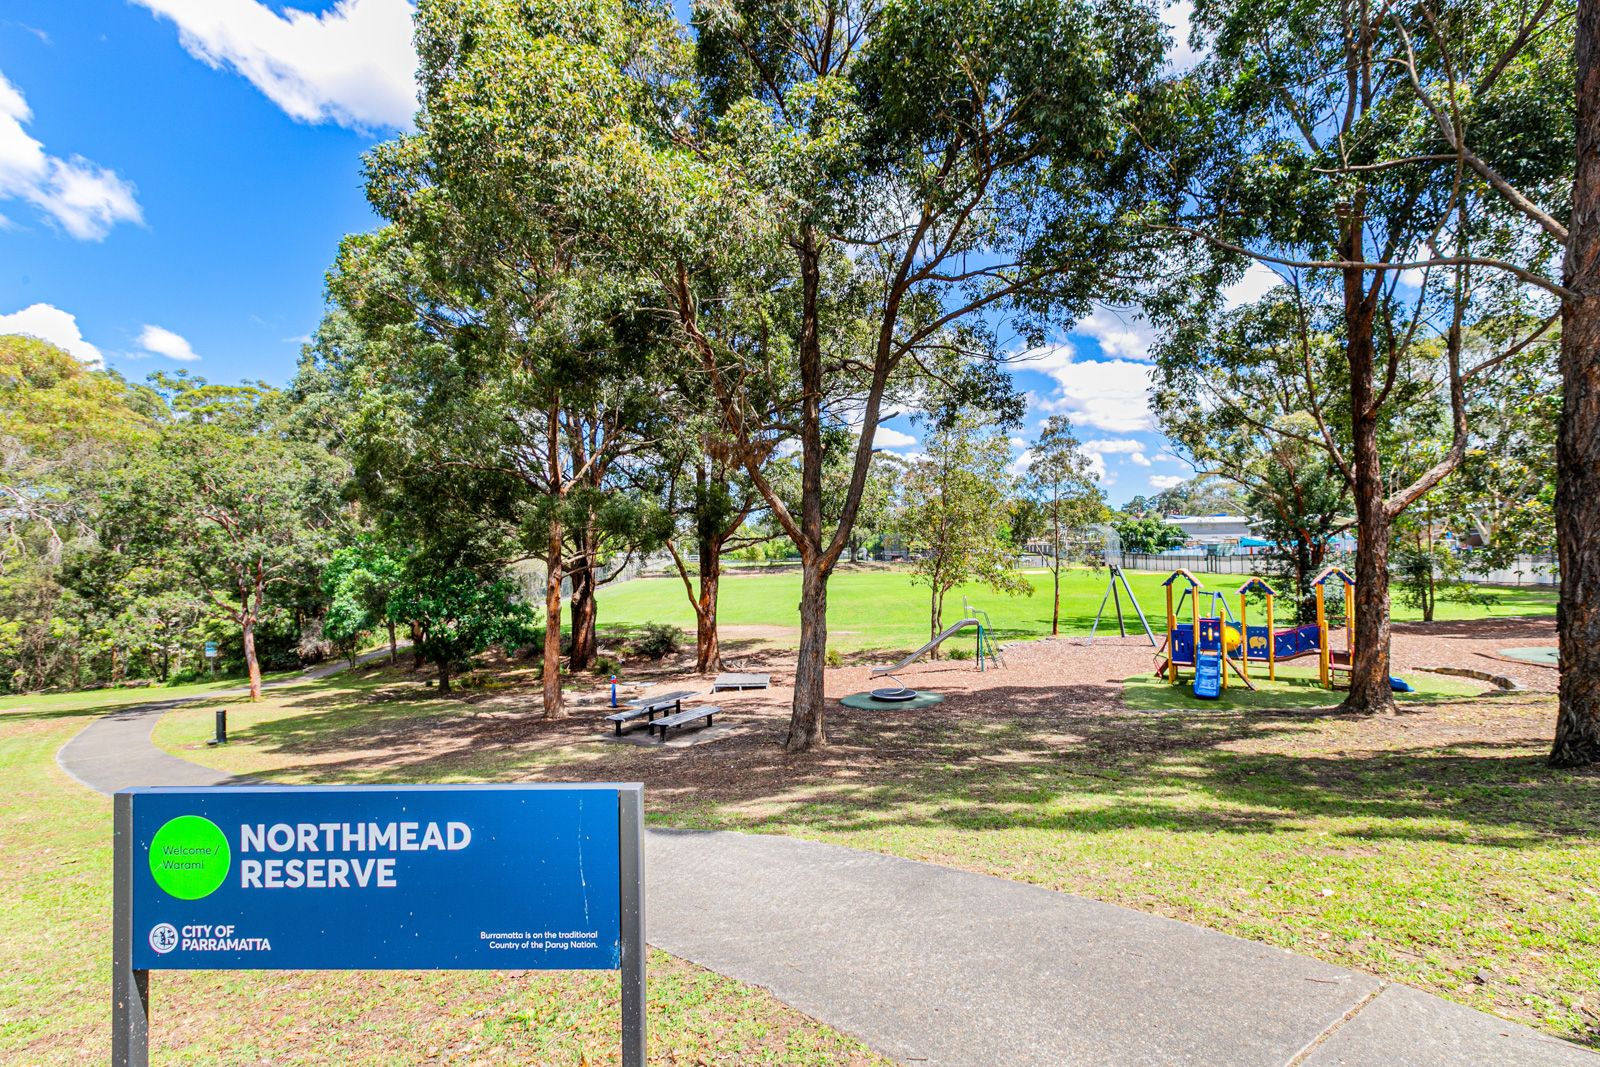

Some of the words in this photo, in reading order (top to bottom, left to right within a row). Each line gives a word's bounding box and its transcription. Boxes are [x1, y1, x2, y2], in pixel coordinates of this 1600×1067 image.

[240, 822, 472, 852] NORTHMEAD
[162, 845, 212, 855] Welcome
[162, 859, 204, 870] Warami
[240, 858, 397, 888] RESERVE
[182, 925, 212, 938] CITY
[214, 925, 235, 938] OF
[480, 931, 523, 939] Burramatta
[525, 931, 531, 939] is
[544, 931, 557, 939] the
[558, 931, 598, 939] traditional
[181, 938, 271, 951] PARRAMATTA
[489, 941, 519, 950] Country
[521, 941, 530, 949] of
[531, 941, 543, 949] the
[545, 941, 569, 950] Darug
[570, 941, 598, 949] Nation.
